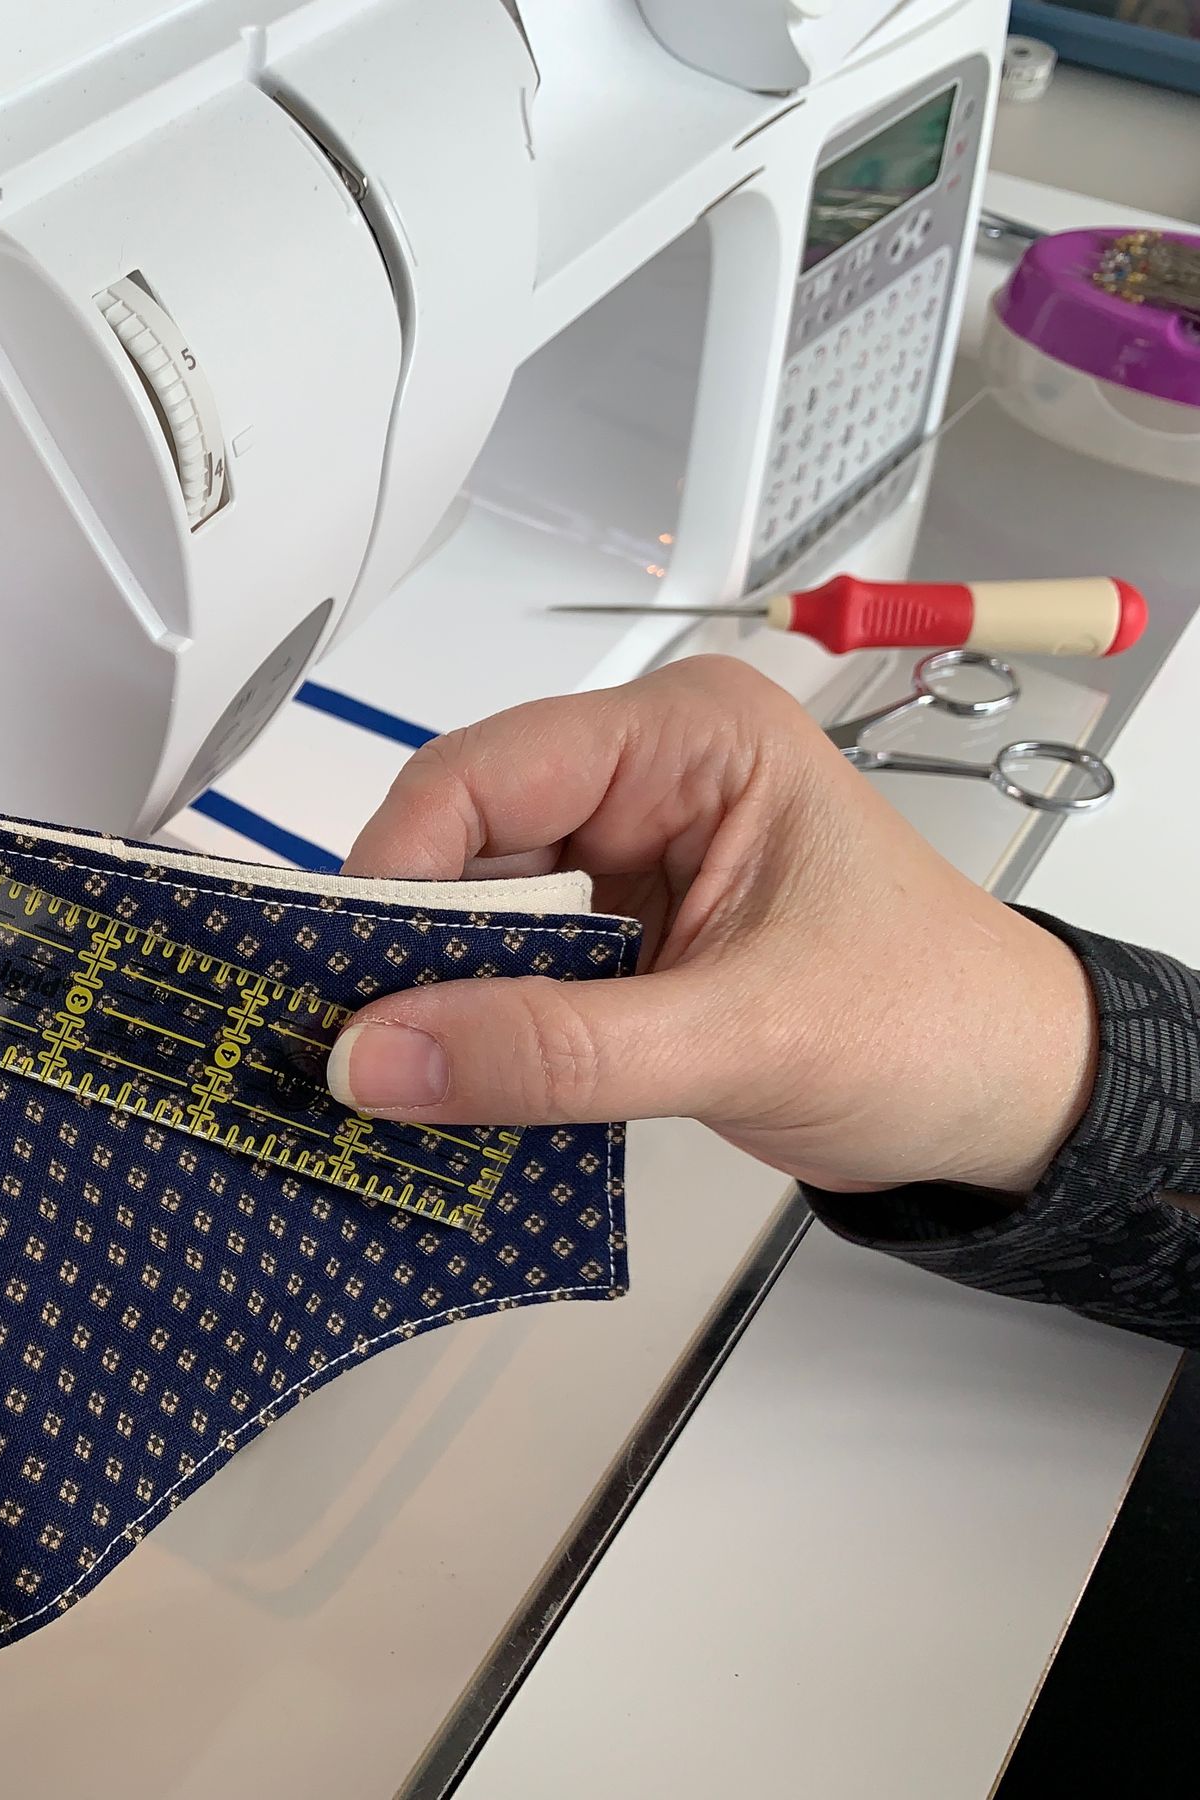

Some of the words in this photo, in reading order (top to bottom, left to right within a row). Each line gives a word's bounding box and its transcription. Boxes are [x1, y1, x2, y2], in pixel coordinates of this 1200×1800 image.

[180, 347, 197, 371] 5
[214, 457, 224, 478] 4
[70, 992, 89, 1008] 3
[220, 1048, 237, 1062] 4
